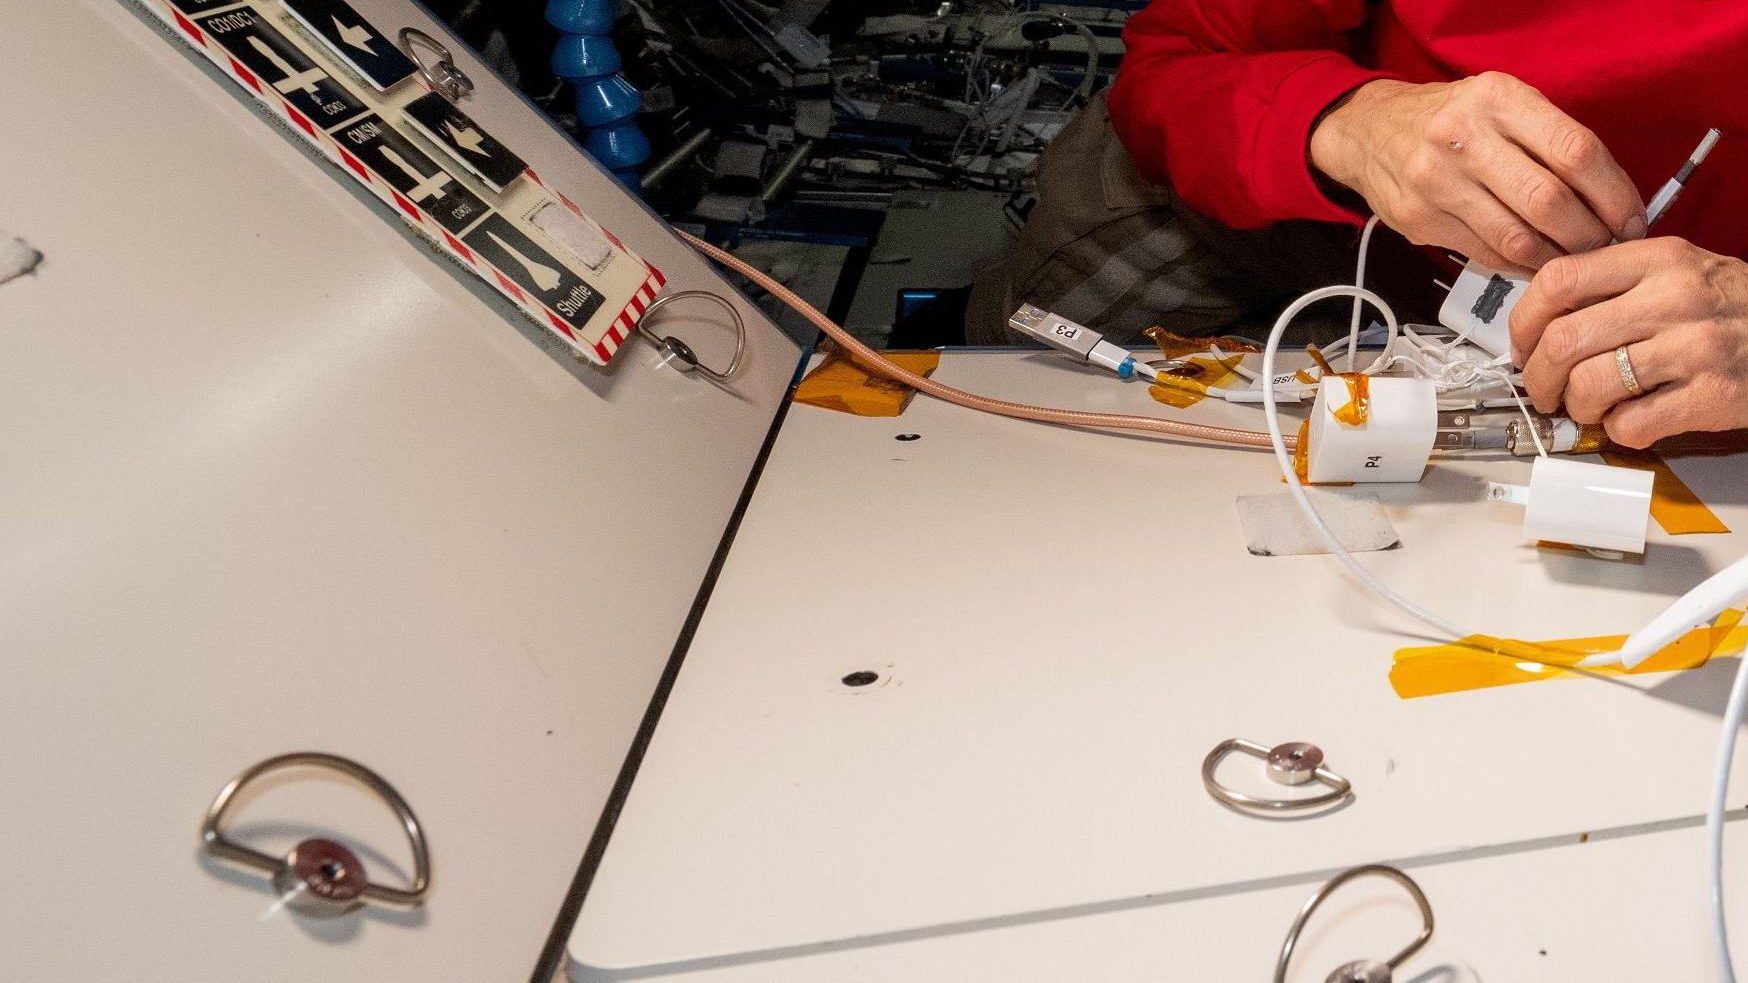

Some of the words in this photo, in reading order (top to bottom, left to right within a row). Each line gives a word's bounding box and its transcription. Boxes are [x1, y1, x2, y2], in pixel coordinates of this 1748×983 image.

[556, 285, 592, 317] Shuttle
[1055, 325, 1078, 339] P3
[1272, 375, 1296, 385] USB
[1364, 455, 1382, 468] P4
